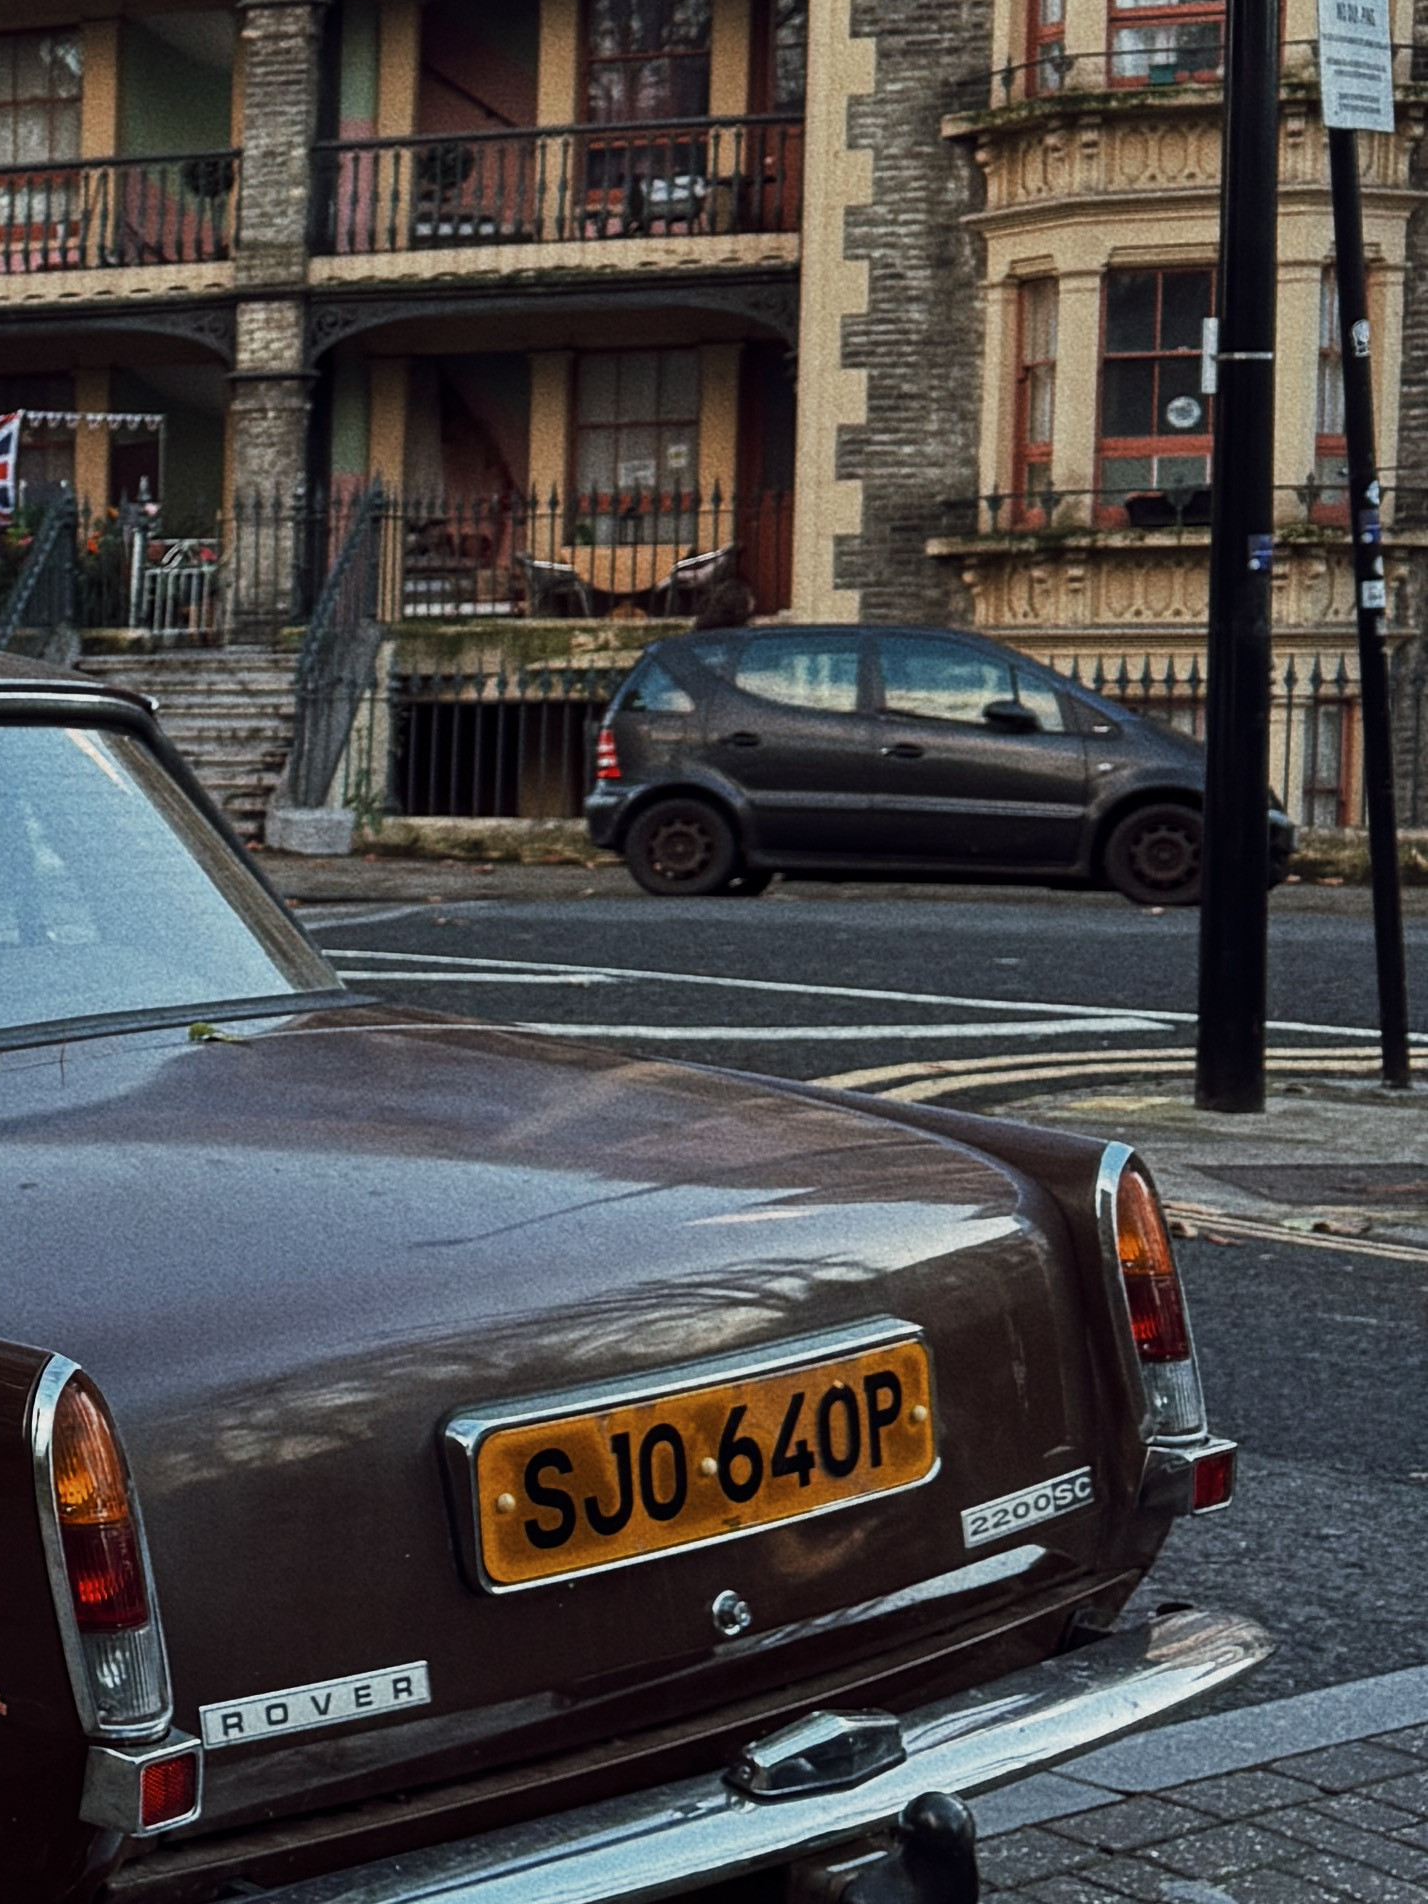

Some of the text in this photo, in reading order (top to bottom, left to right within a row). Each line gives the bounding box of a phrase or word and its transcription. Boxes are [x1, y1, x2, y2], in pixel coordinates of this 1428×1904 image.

[523, 1370, 903, 1550] SJO 640P
[221, 1676, 413, 1737] ROVER
